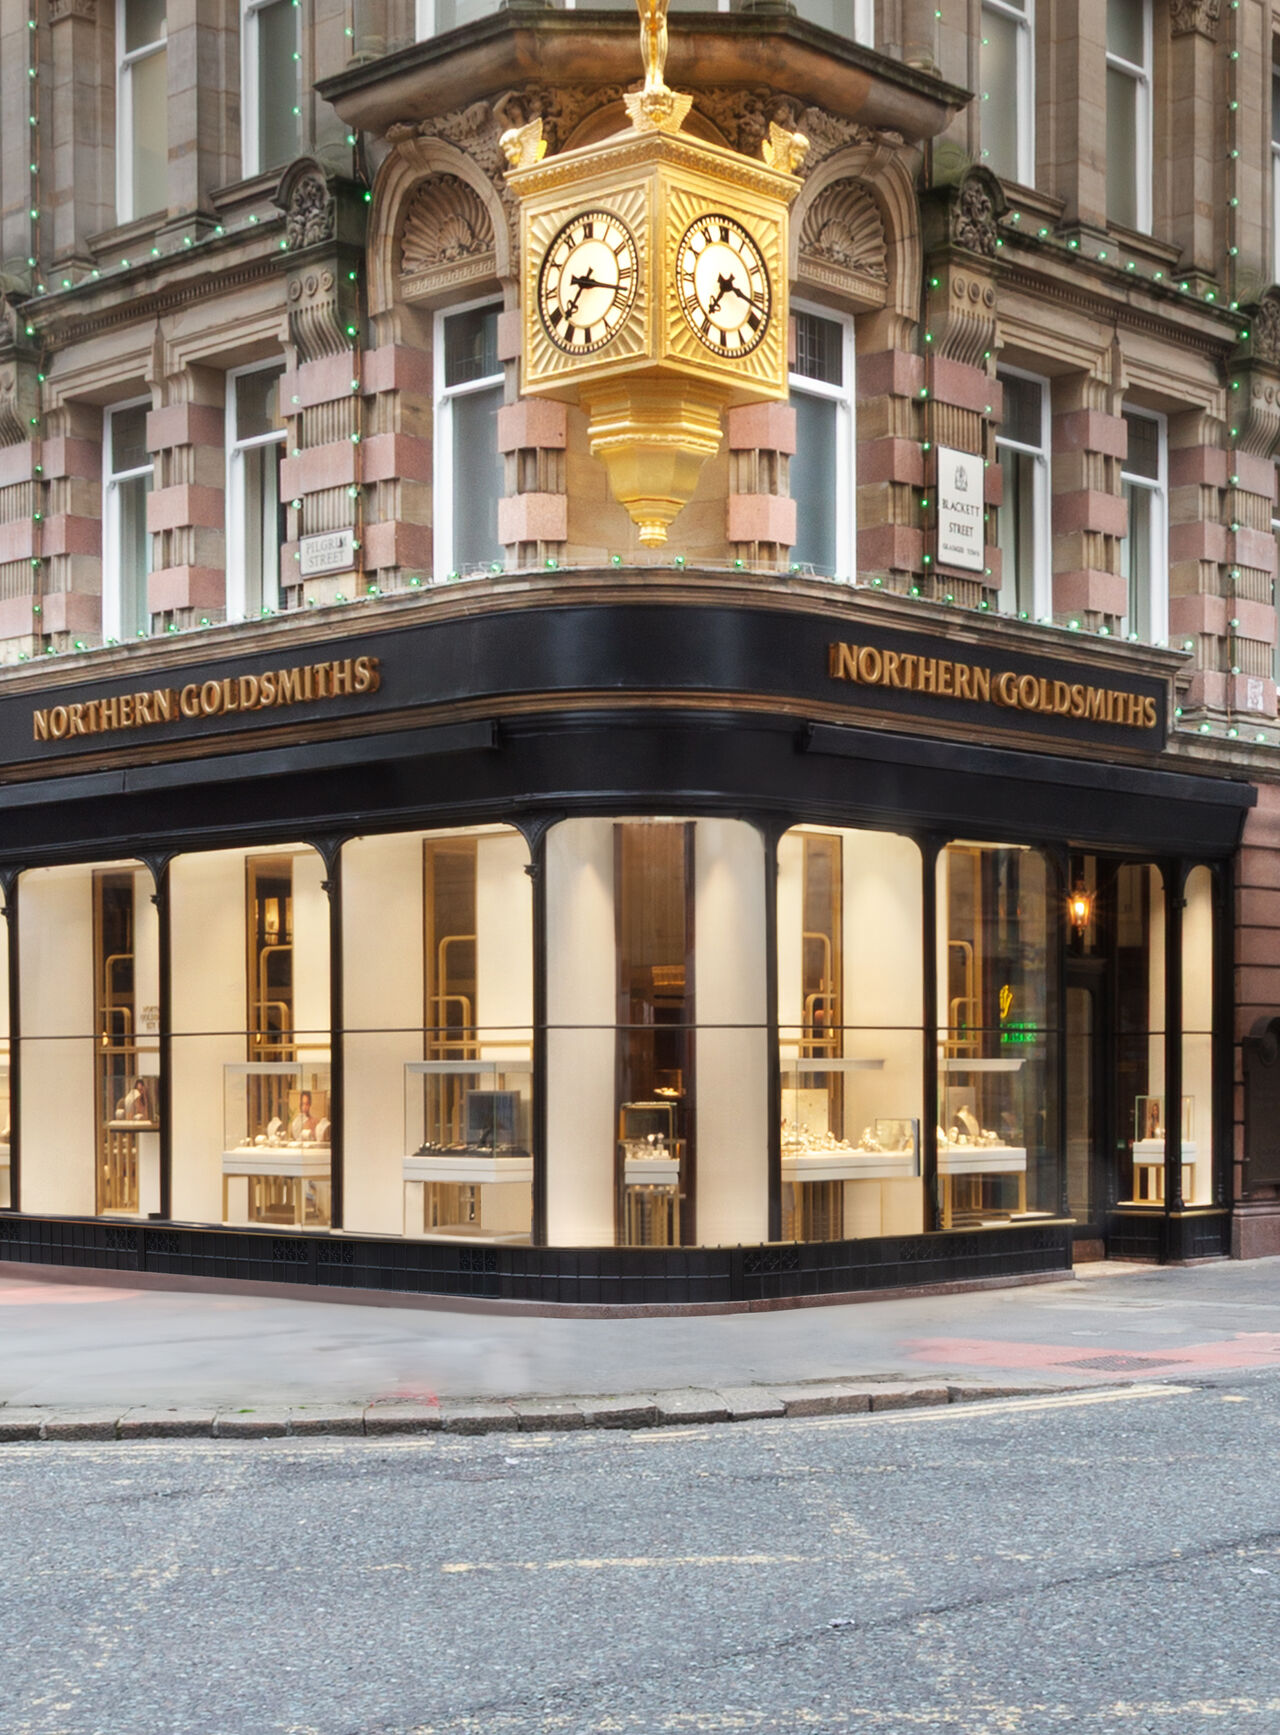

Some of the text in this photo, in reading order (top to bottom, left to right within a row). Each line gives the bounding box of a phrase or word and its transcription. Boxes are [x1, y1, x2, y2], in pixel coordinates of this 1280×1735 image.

[942, 499, 980, 517] BLACKETT
[949, 521, 974, 537] STREET
[306, 536, 347, 555] PILGRIM
[309, 550, 345, 568] STREET
[829, 642, 1158, 728] NORTHERN GOLDSMITHS
[33, 656, 381, 741] NORTHERN GOLDSMITHS
